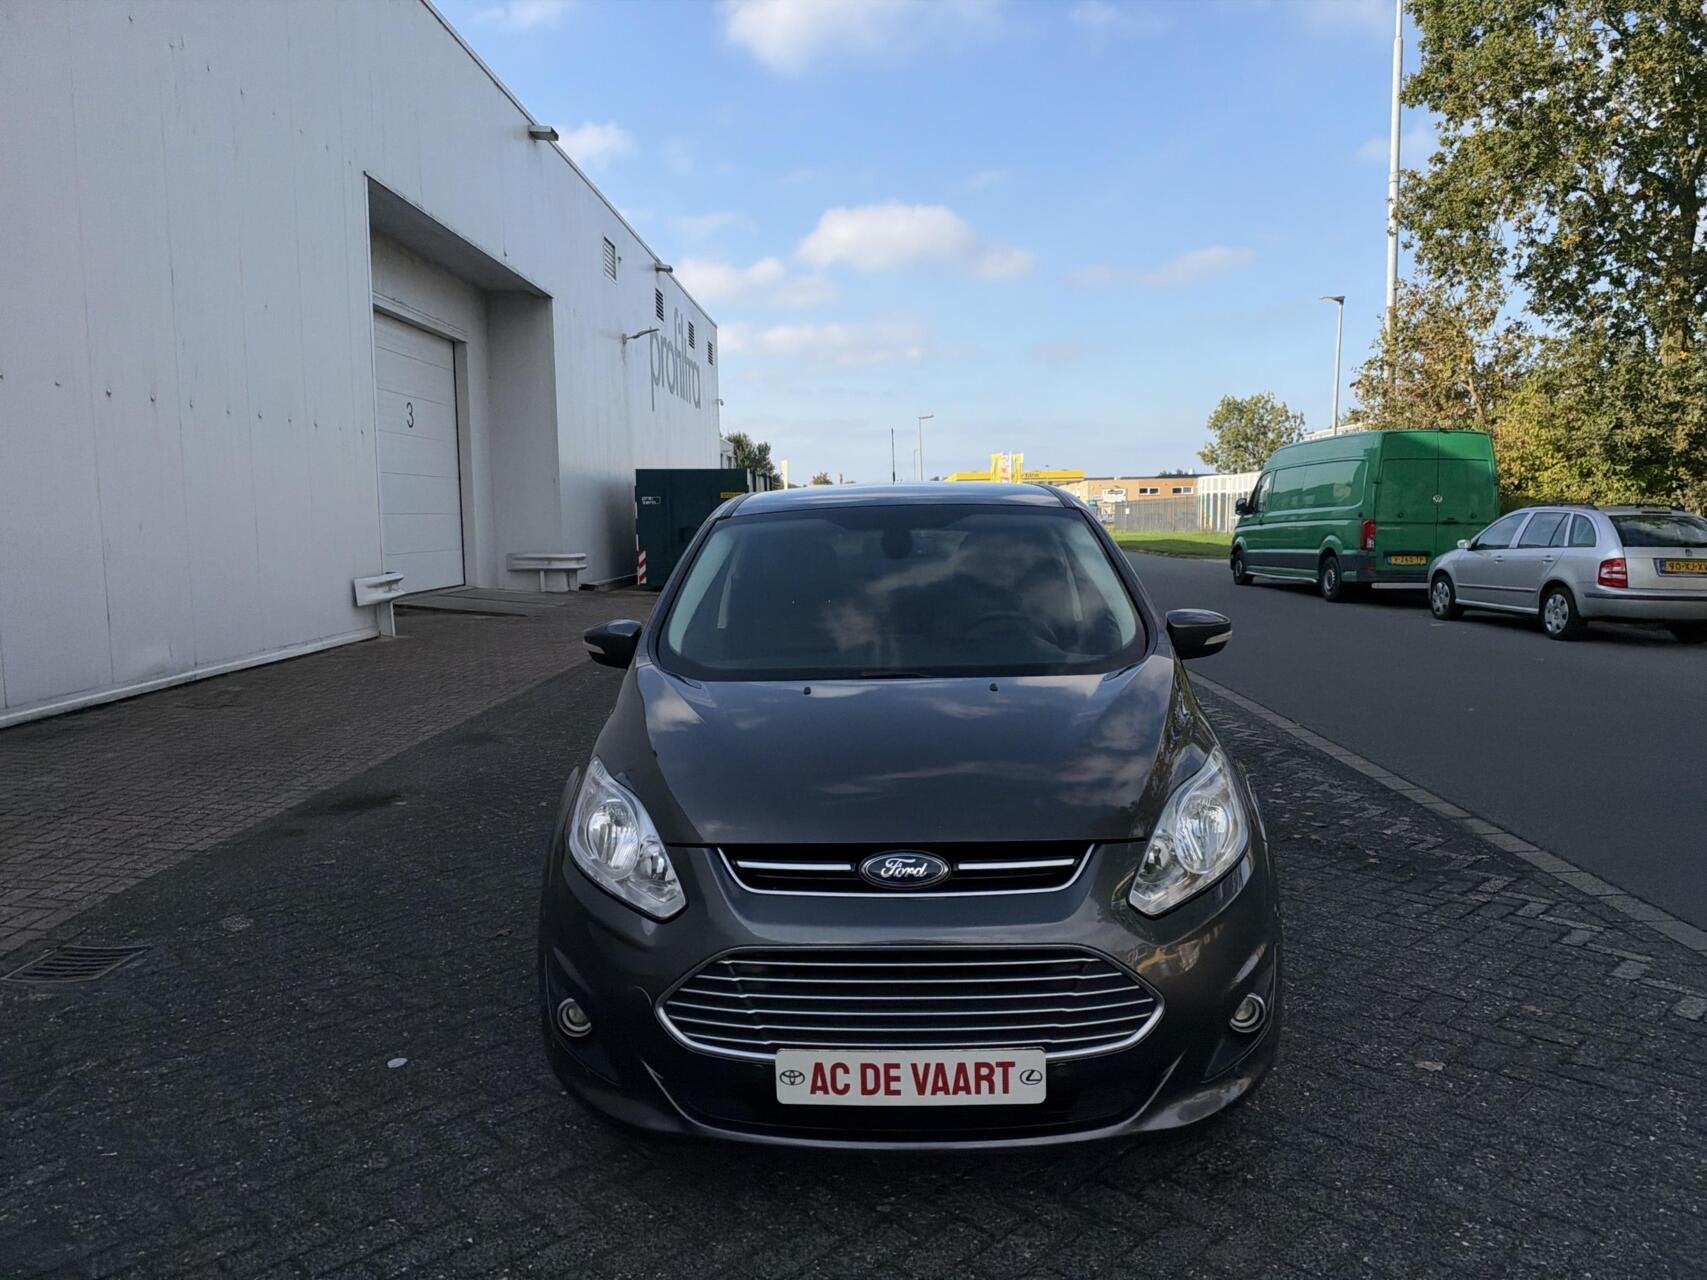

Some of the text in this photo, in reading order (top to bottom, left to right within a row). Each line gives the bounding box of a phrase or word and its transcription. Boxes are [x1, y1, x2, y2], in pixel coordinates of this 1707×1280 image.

[406, 401, 415, 429] 3
[880, 857, 928, 878] Ford
[809, 1061, 1016, 1096] AC DE VAART
